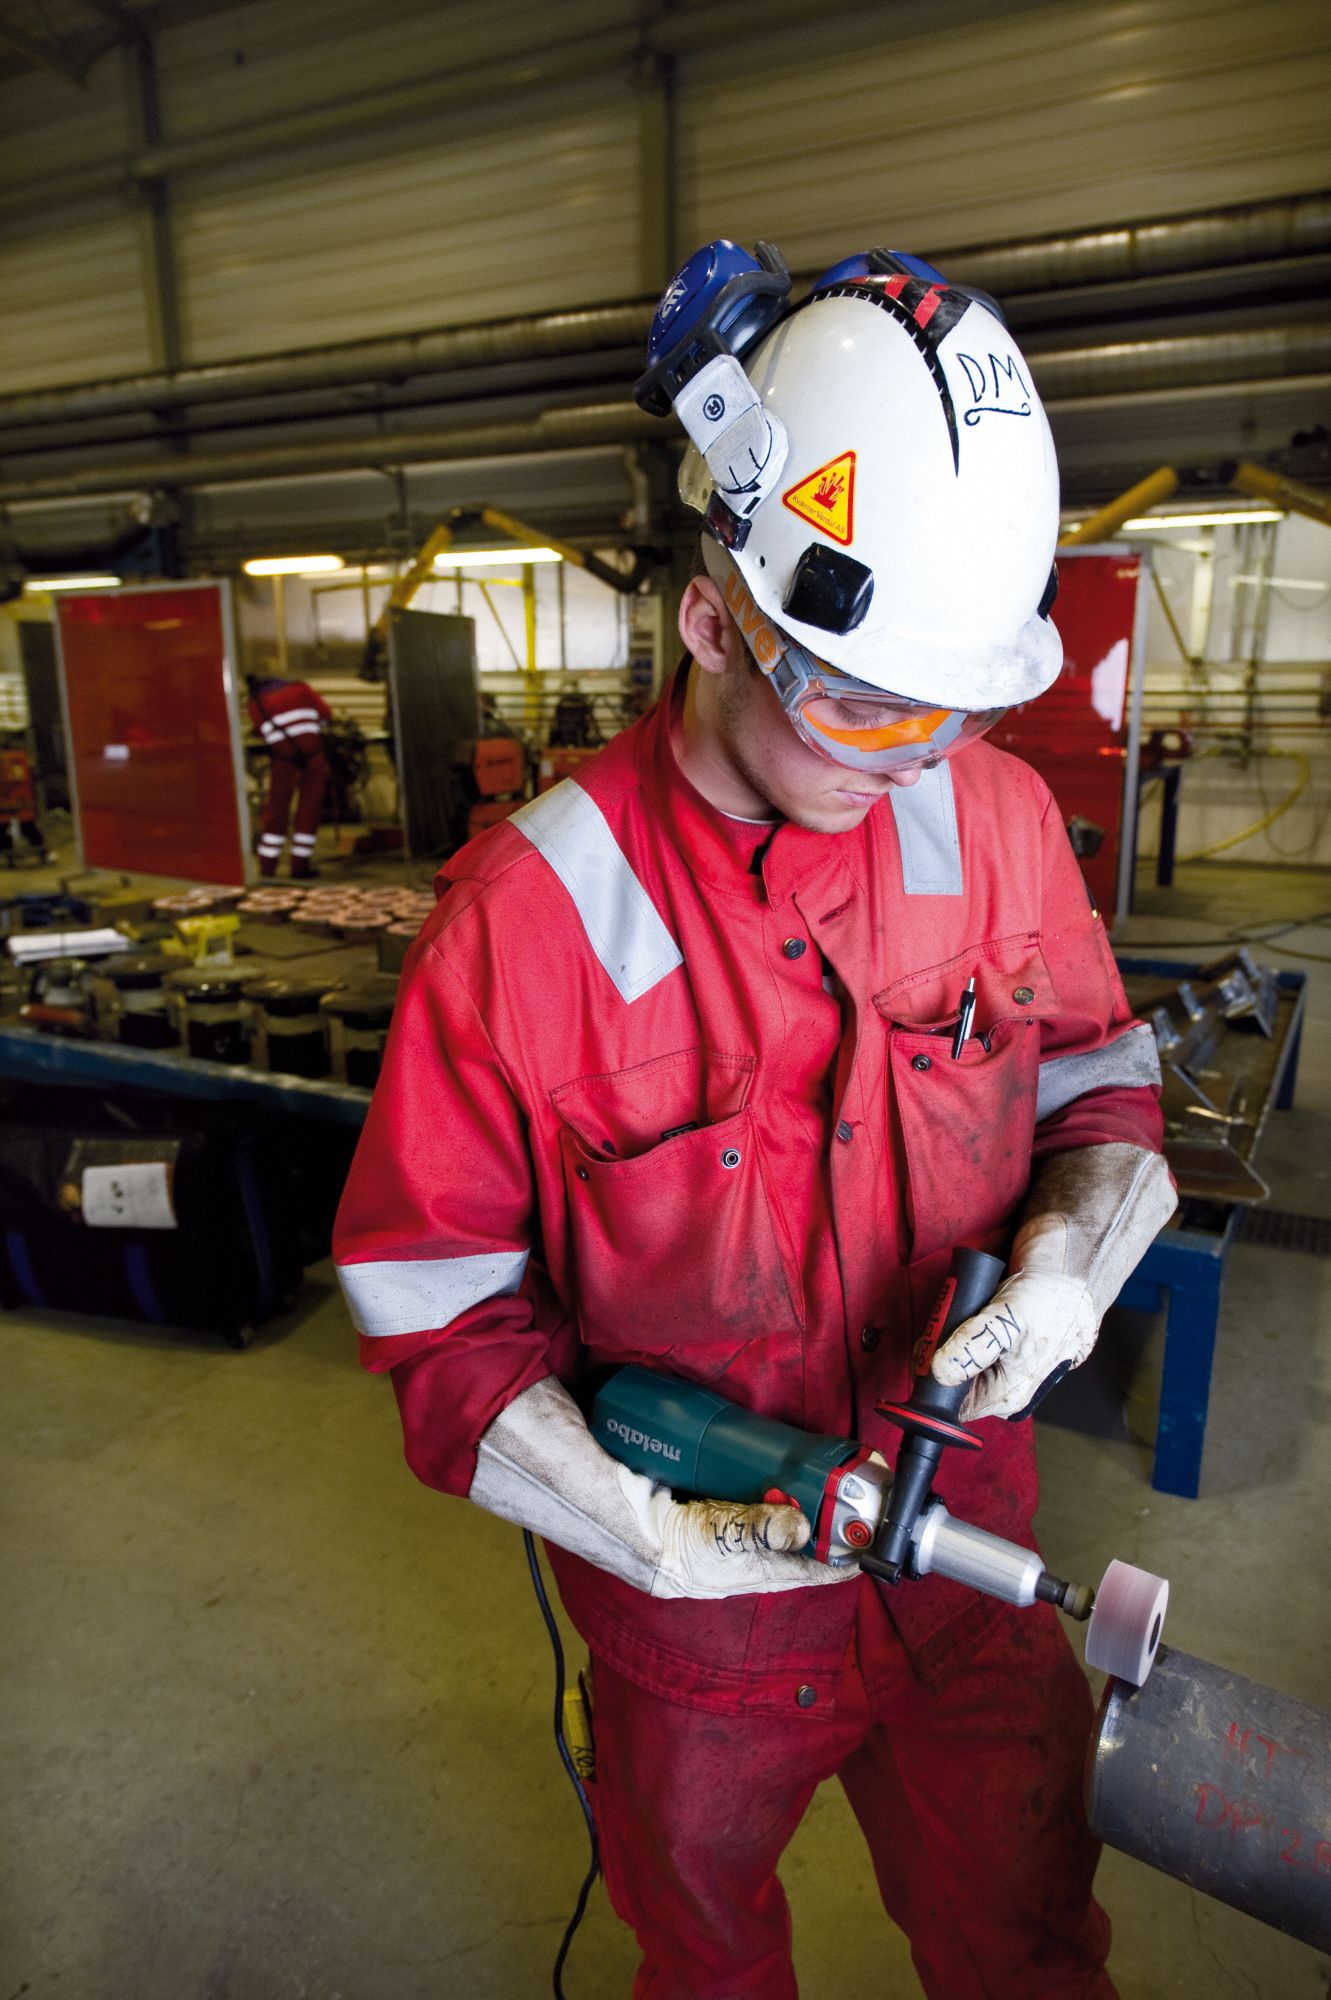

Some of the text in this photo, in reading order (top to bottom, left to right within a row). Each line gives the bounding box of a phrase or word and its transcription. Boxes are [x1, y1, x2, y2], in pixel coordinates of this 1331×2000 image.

[956, 352, 1030, 403] DM
[725, 570, 782, 669] uve
[606, 1419, 681, 1462] metabo
